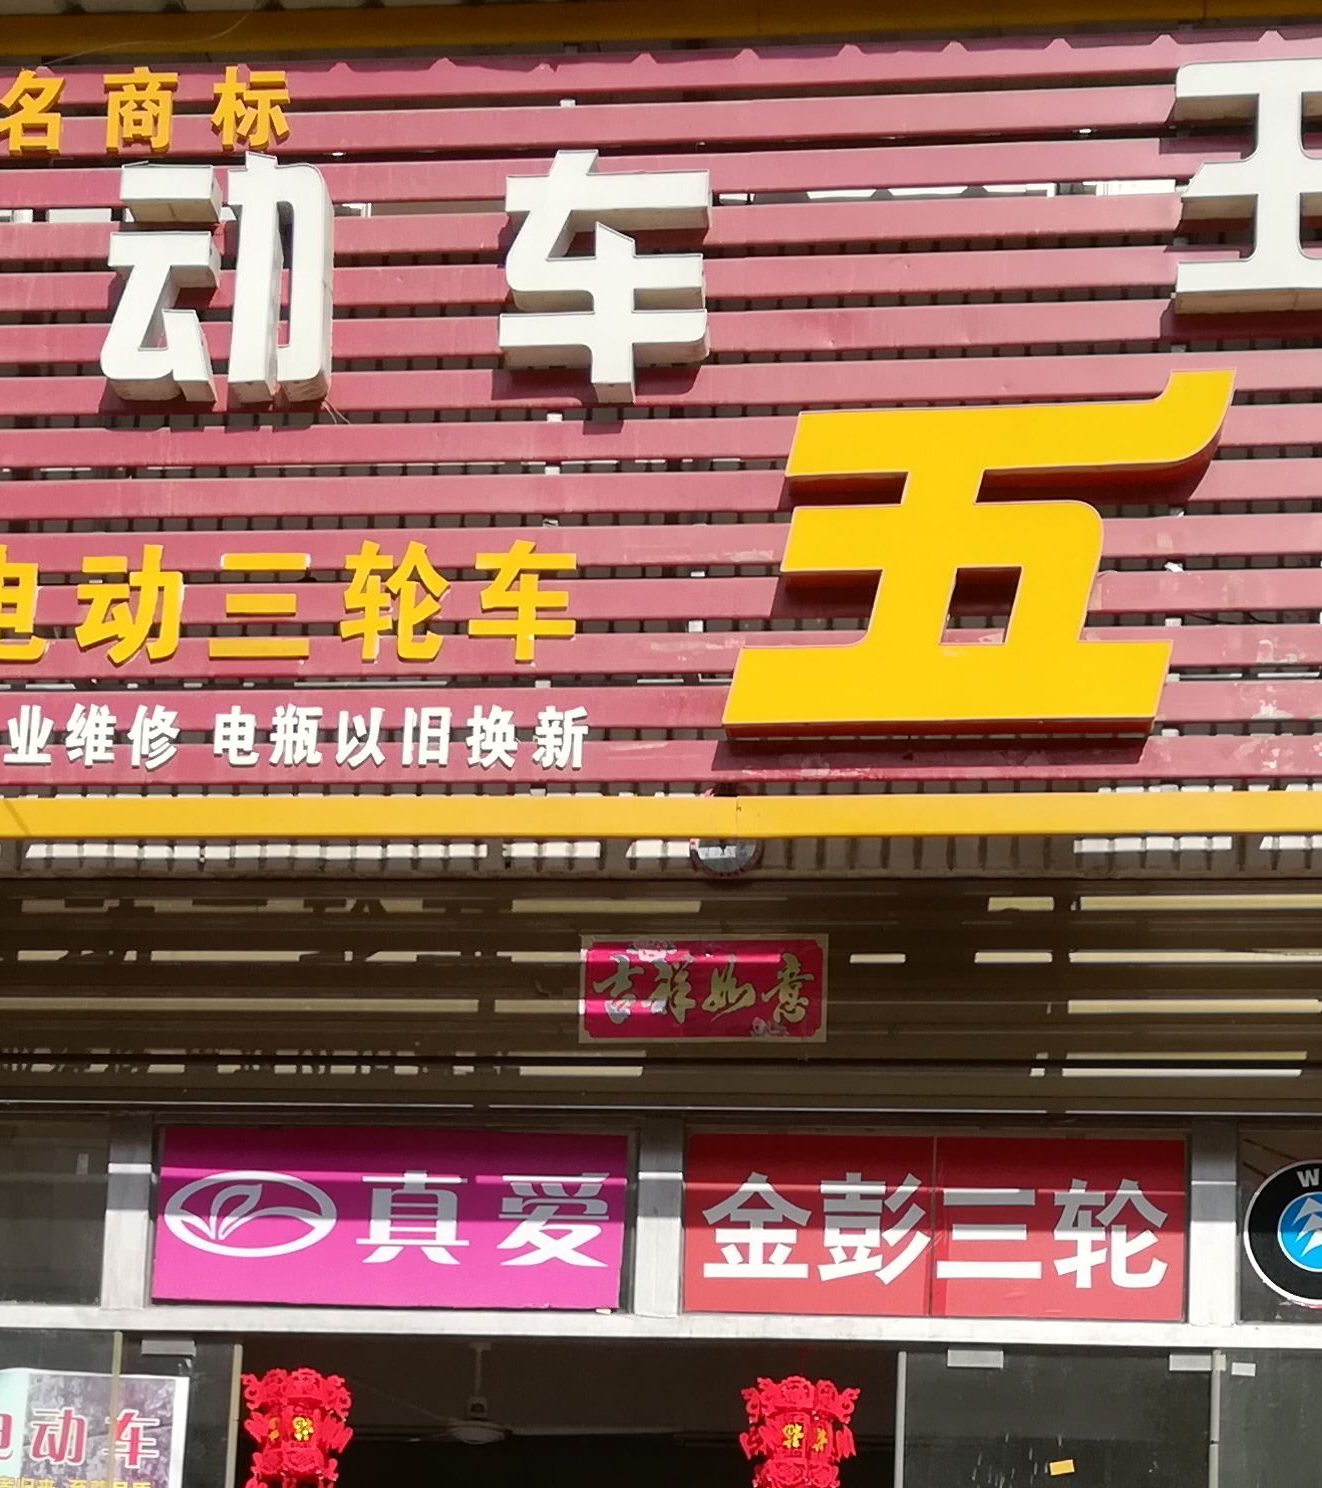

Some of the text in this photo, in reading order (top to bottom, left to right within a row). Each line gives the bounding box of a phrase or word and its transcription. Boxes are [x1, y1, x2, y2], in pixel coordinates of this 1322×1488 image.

[210, 701, 590, 771] 电瓶以旧换新
[593, 953, 815, 1024] 吉祥如意
[355, 1170, 611, 1268] 真爱
[702, 1170, 1171, 1287] 金彭三轮
